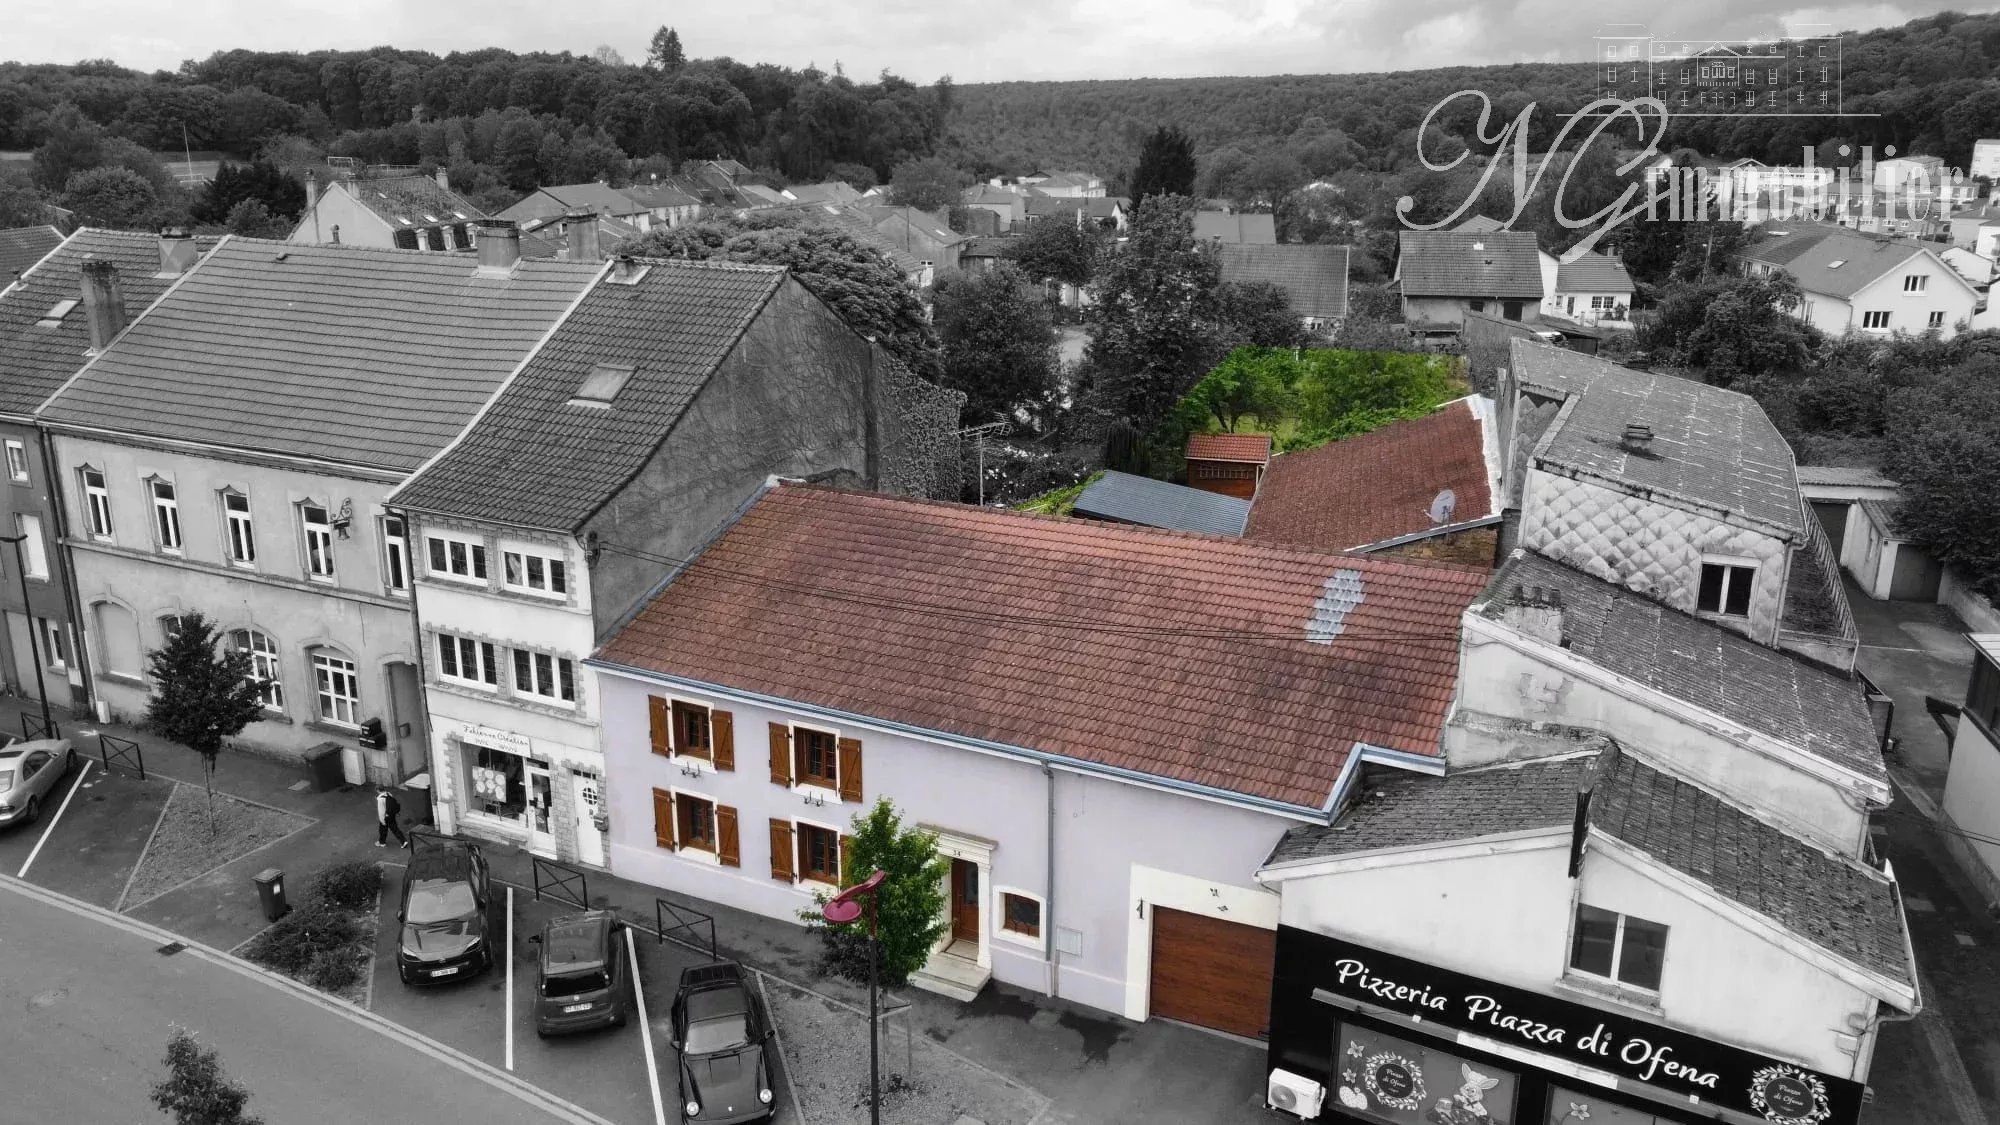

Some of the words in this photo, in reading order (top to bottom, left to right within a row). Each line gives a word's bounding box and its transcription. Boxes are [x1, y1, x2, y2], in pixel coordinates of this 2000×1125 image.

[1335, 959, 1447, 1011] Pizzeria
[1464, 995, 1566, 1043] Piazza
[1576, 1023, 1613, 1056] di
[1620, 1038, 1720, 1088] Ofena
